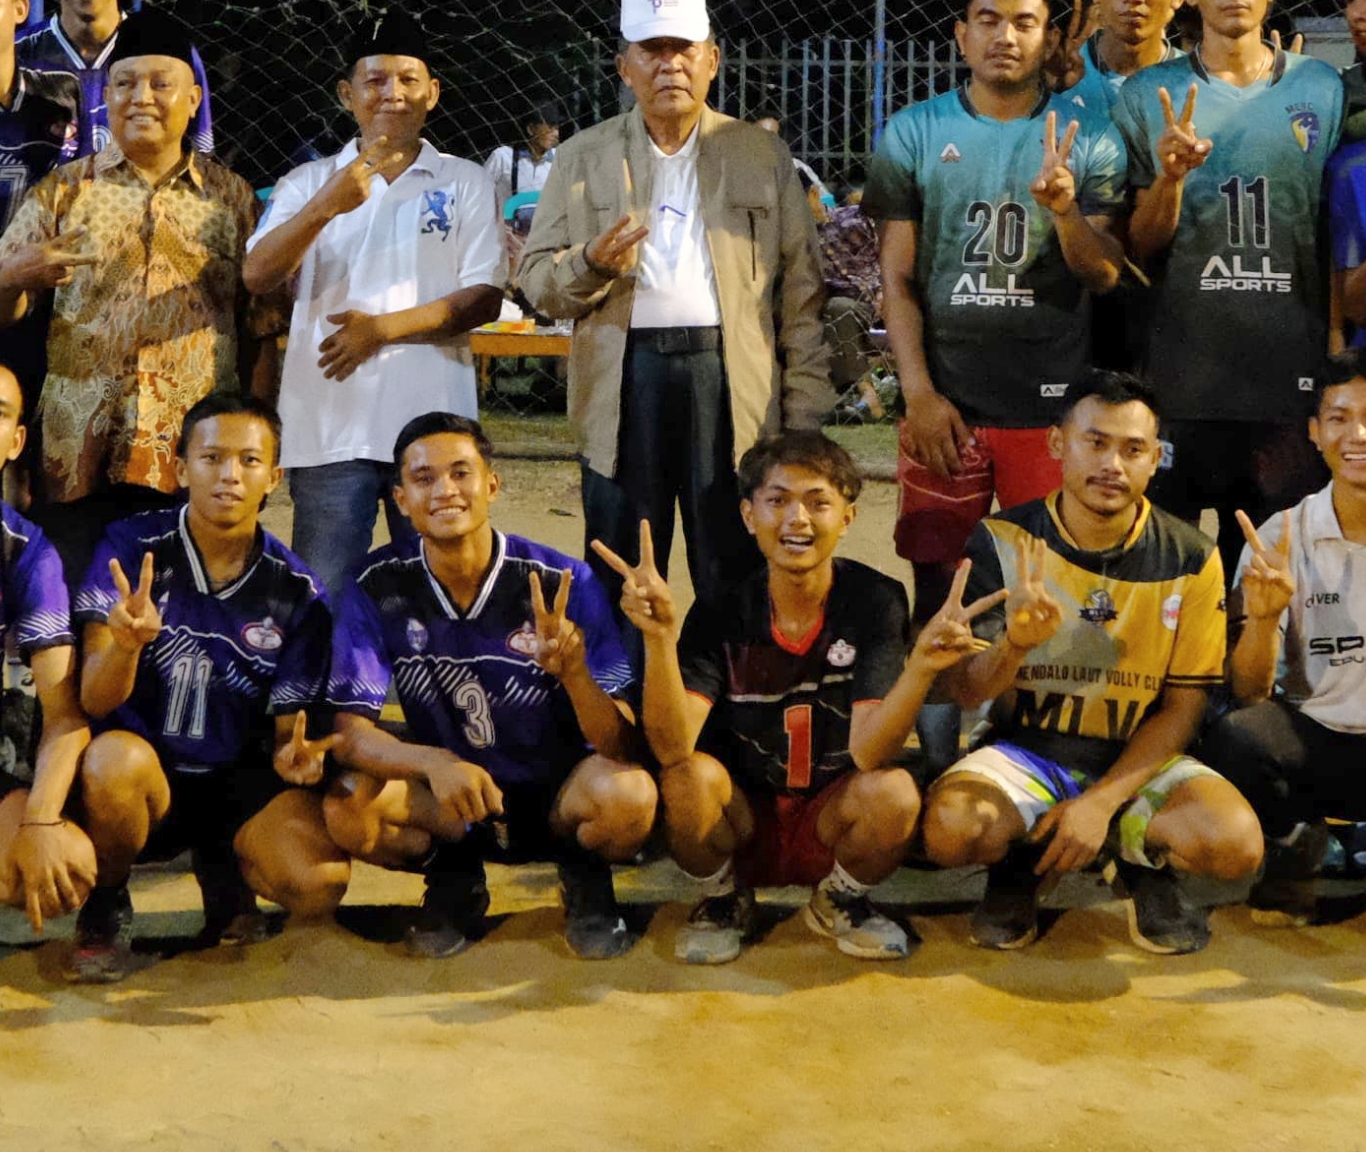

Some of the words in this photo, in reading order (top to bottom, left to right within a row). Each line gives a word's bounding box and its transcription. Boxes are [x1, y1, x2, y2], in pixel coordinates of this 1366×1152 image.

[961, 200, 1030, 267] 20
[1217, 174, 1271, 249] 11
[951, 272, 1035, 295] ALL
[1199, 277, 1293, 293] SPORTS
[1200, 253, 1293, 280] ALL
[949, 294, 1036, 308] SPORTS
[162, 652, 215, 740] 11
[1072, 666, 1103, 684] LAUT
[1105, 669, 1141, 689] VOLLY
[452, 678, 496, 749] 3
[783, 704, 813, 788] 1
